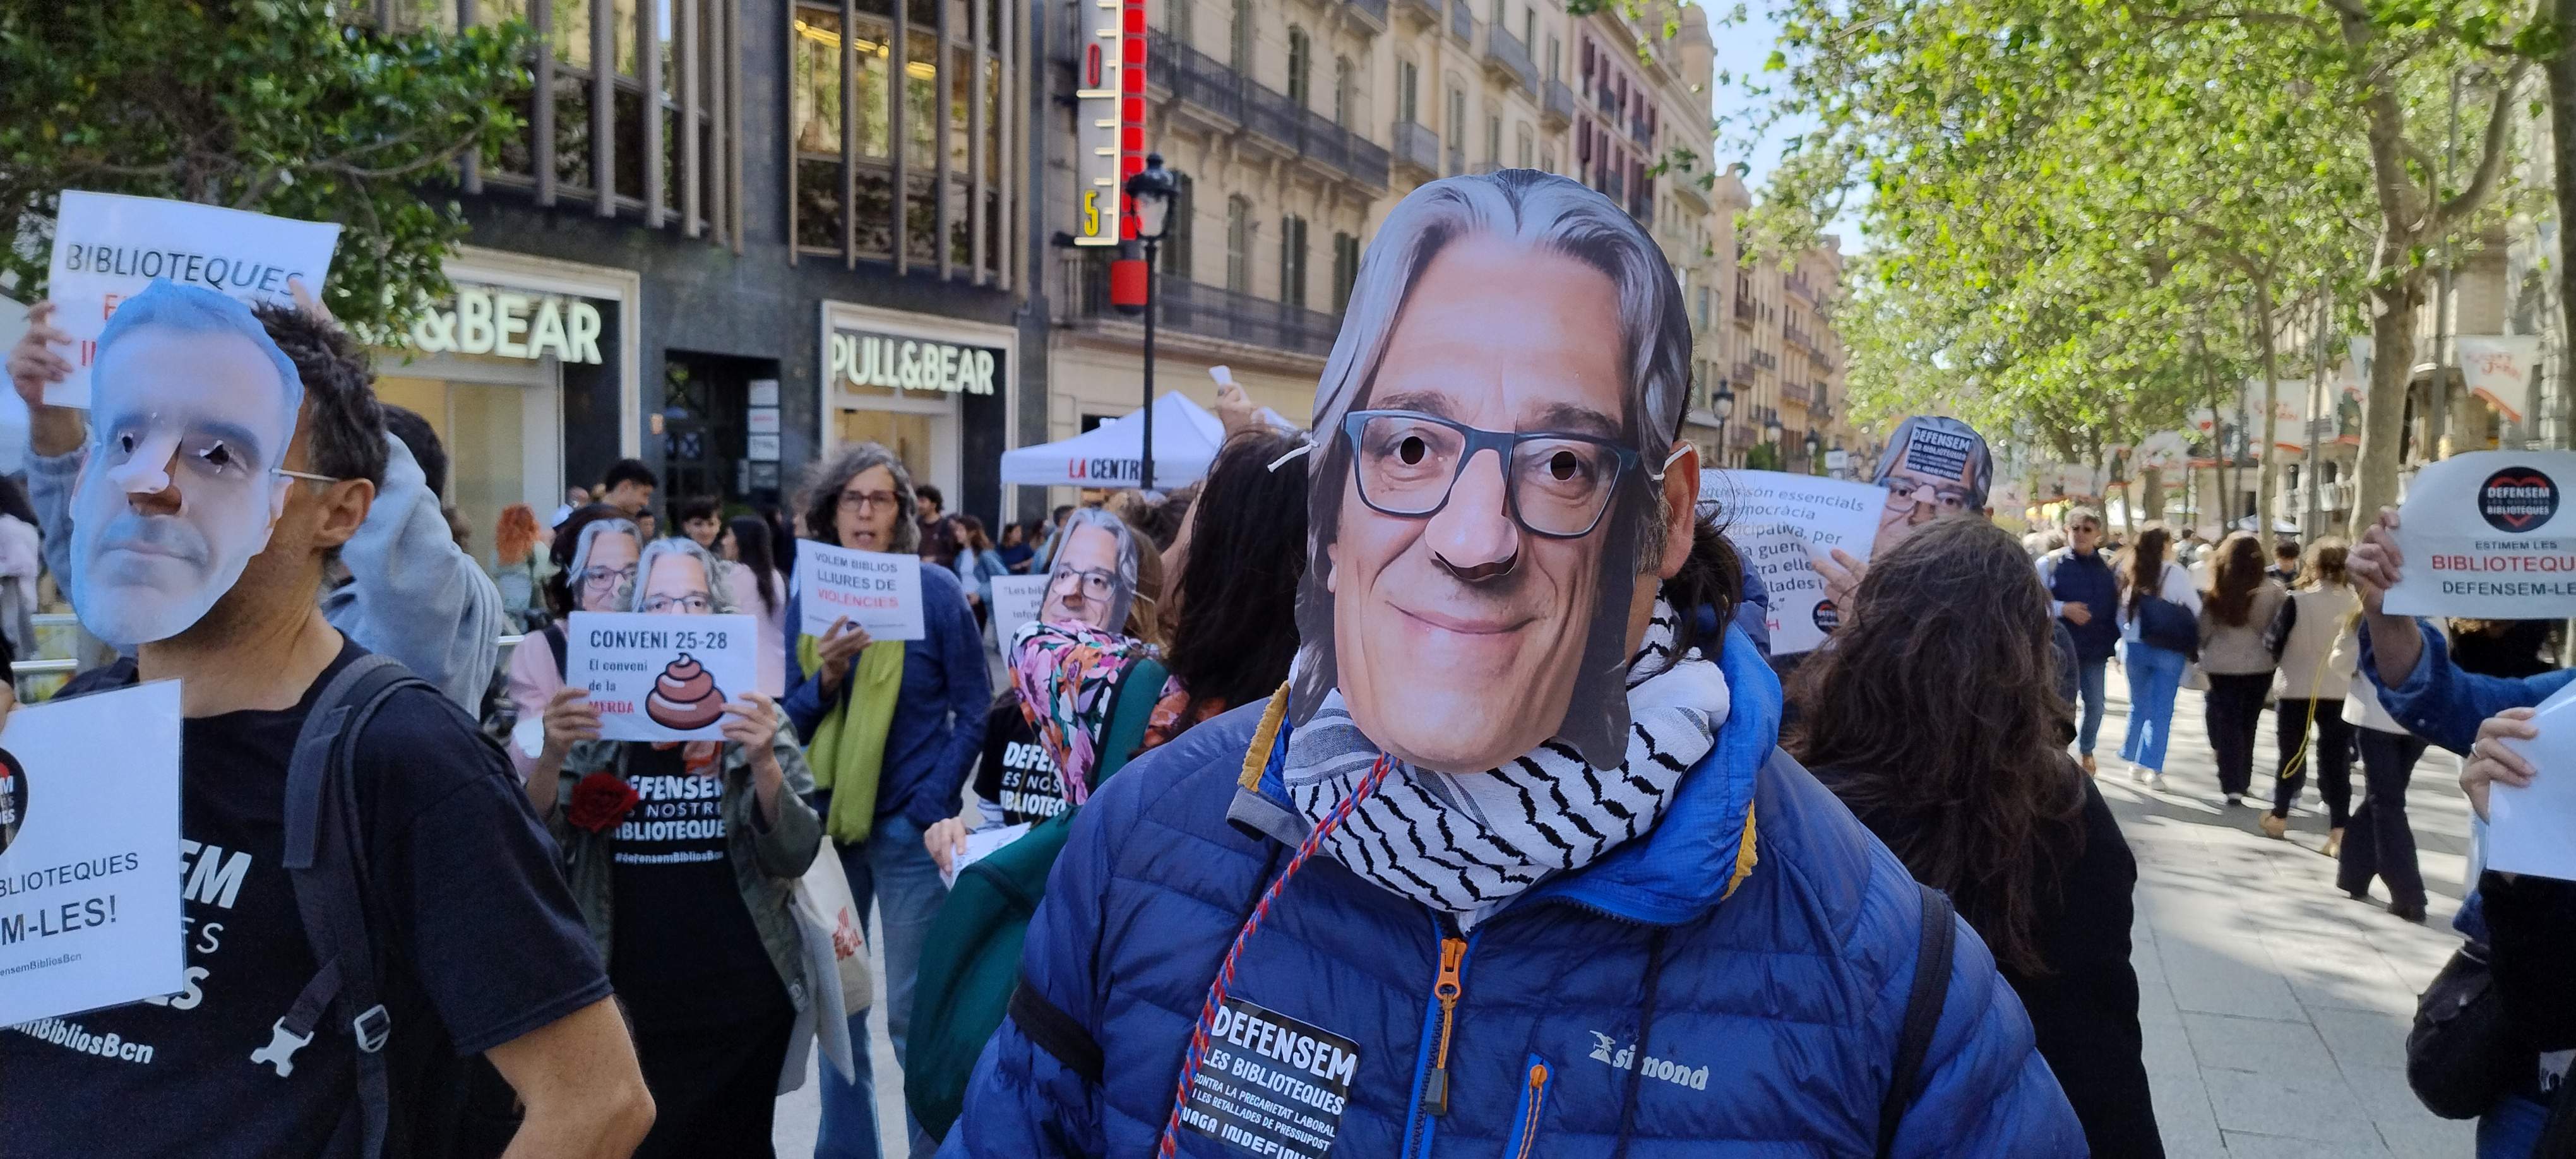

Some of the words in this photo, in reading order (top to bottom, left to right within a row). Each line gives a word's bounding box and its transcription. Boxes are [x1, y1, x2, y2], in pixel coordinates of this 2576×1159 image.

[1087, 43, 1101, 87] 0
[1084, 190, 1099, 236] 5
[66, 242, 304, 296] BIBLIOTEQUES
[830, 331, 995, 396] PULL&BEAR
[1069, 458, 1086, 478] LA
[1778, 491, 1864, 513] essencials
[2487, 487, 2550, 499] DEFENSEM
[1812, 530, 1842, 545] per
[2475, 540, 2529, 550] ESTIMEM
[2533, 541, 2558, 549] LES
[818, 569, 871, 590] LLIURES
[876, 579, 897, 591] DE
[2432, 555, 2576, 572] BIBLIOTEQU
[590, 630, 667, 649] CONVENI
[676, 631, 727, 650] 25-28
[589, 658, 599, 672] El
[603, 660, 648, 672] conveni
[588, 679, 602, 692] de
[605, 679, 616, 692] la
[2, 894, 116, 946] M-LES!
[1210, 1005, 1357, 1087] DEFENSEM
[1203, 1046, 1231, 1071] LES
[1232, 1057, 1345, 1116] BIBLIOTEQUES
[1613, 1044, 1709, 1091] simond
[1191, 1088, 1197, 1098] I
[1196, 1090, 1212, 1103] LES
[1212, 1097, 1262, 1124] RETALLADES
[1261, 1116, 1274, 1129] DE
[1274, 1121, 1331, 1151] PRESSUPOST
[1194, 1073, 1224, 1093] CONTRA
[1225, 1085, 1237, 1098] LA
[1239, 1090, 1294, 1120] PRECARIETAT
[1294, 1112, 1335, 1138] LABORAL
